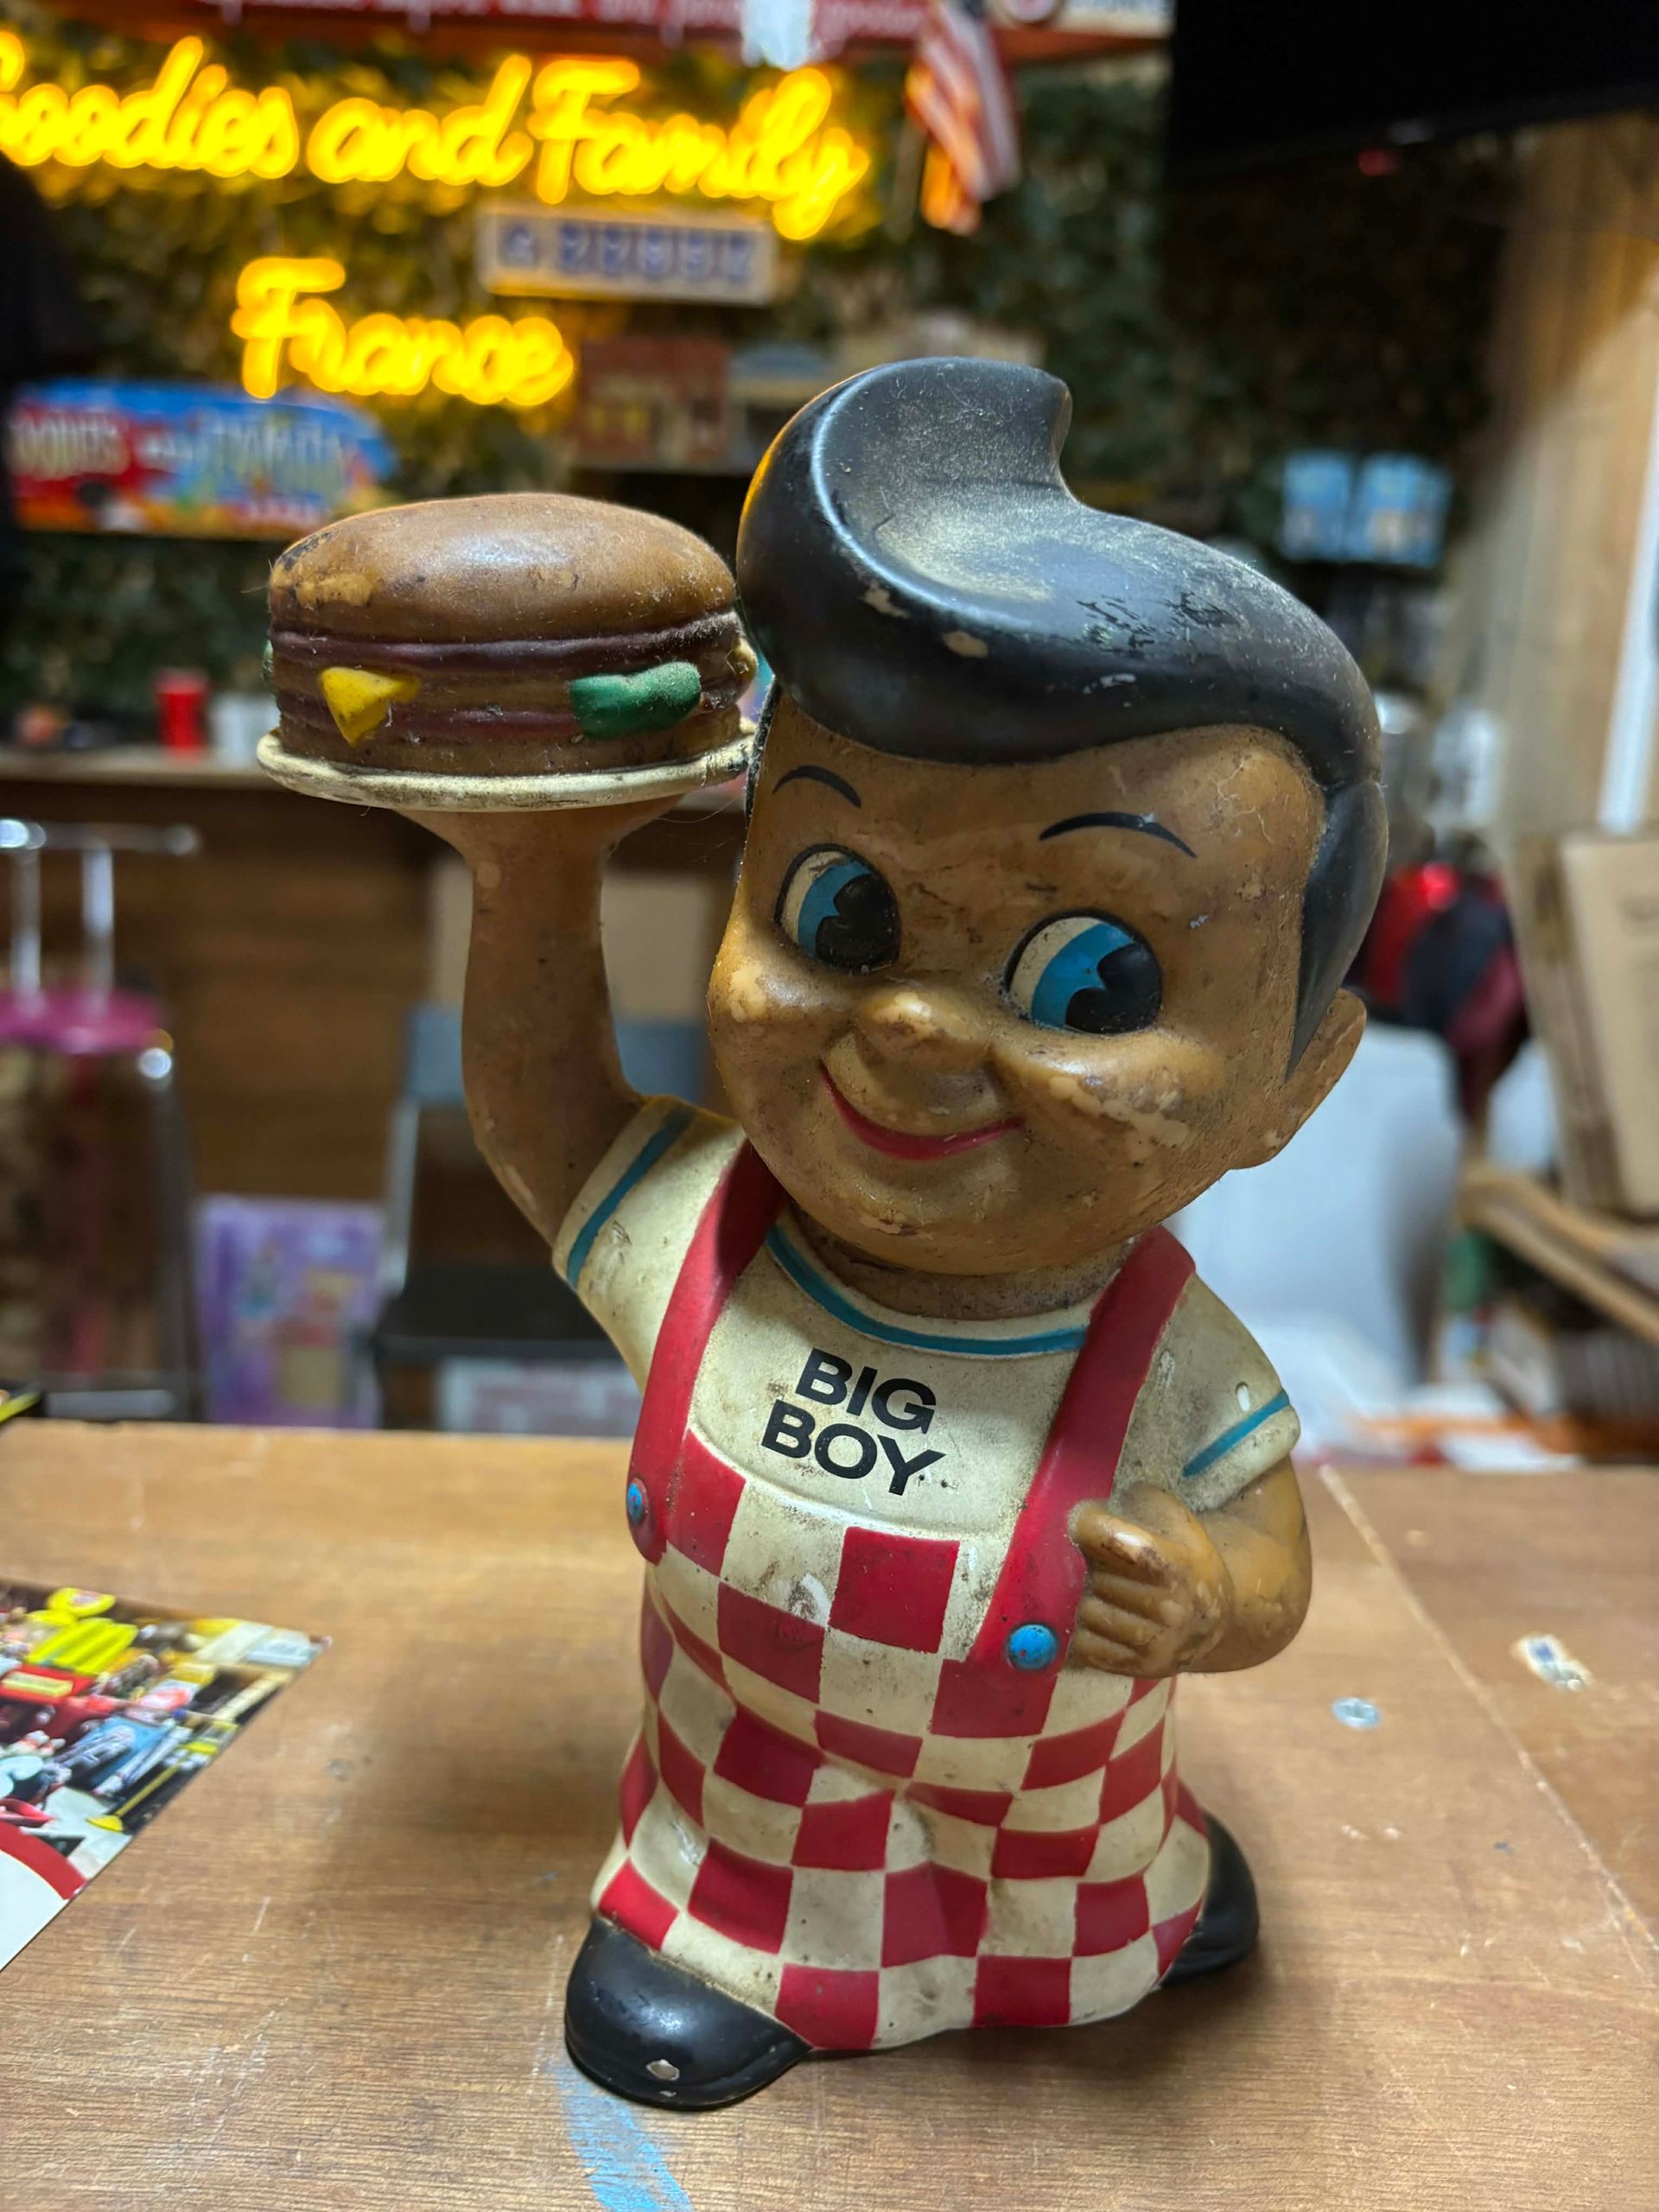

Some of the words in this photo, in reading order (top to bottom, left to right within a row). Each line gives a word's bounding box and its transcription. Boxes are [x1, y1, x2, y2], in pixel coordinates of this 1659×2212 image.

[307, 54, 532, 184] and
[527, 58, 868, 239] Family
[231, 257, 573, 404] France
[761, 1398, 947, 1497] BOY
[795, 1347, 937, 1434] BIG
